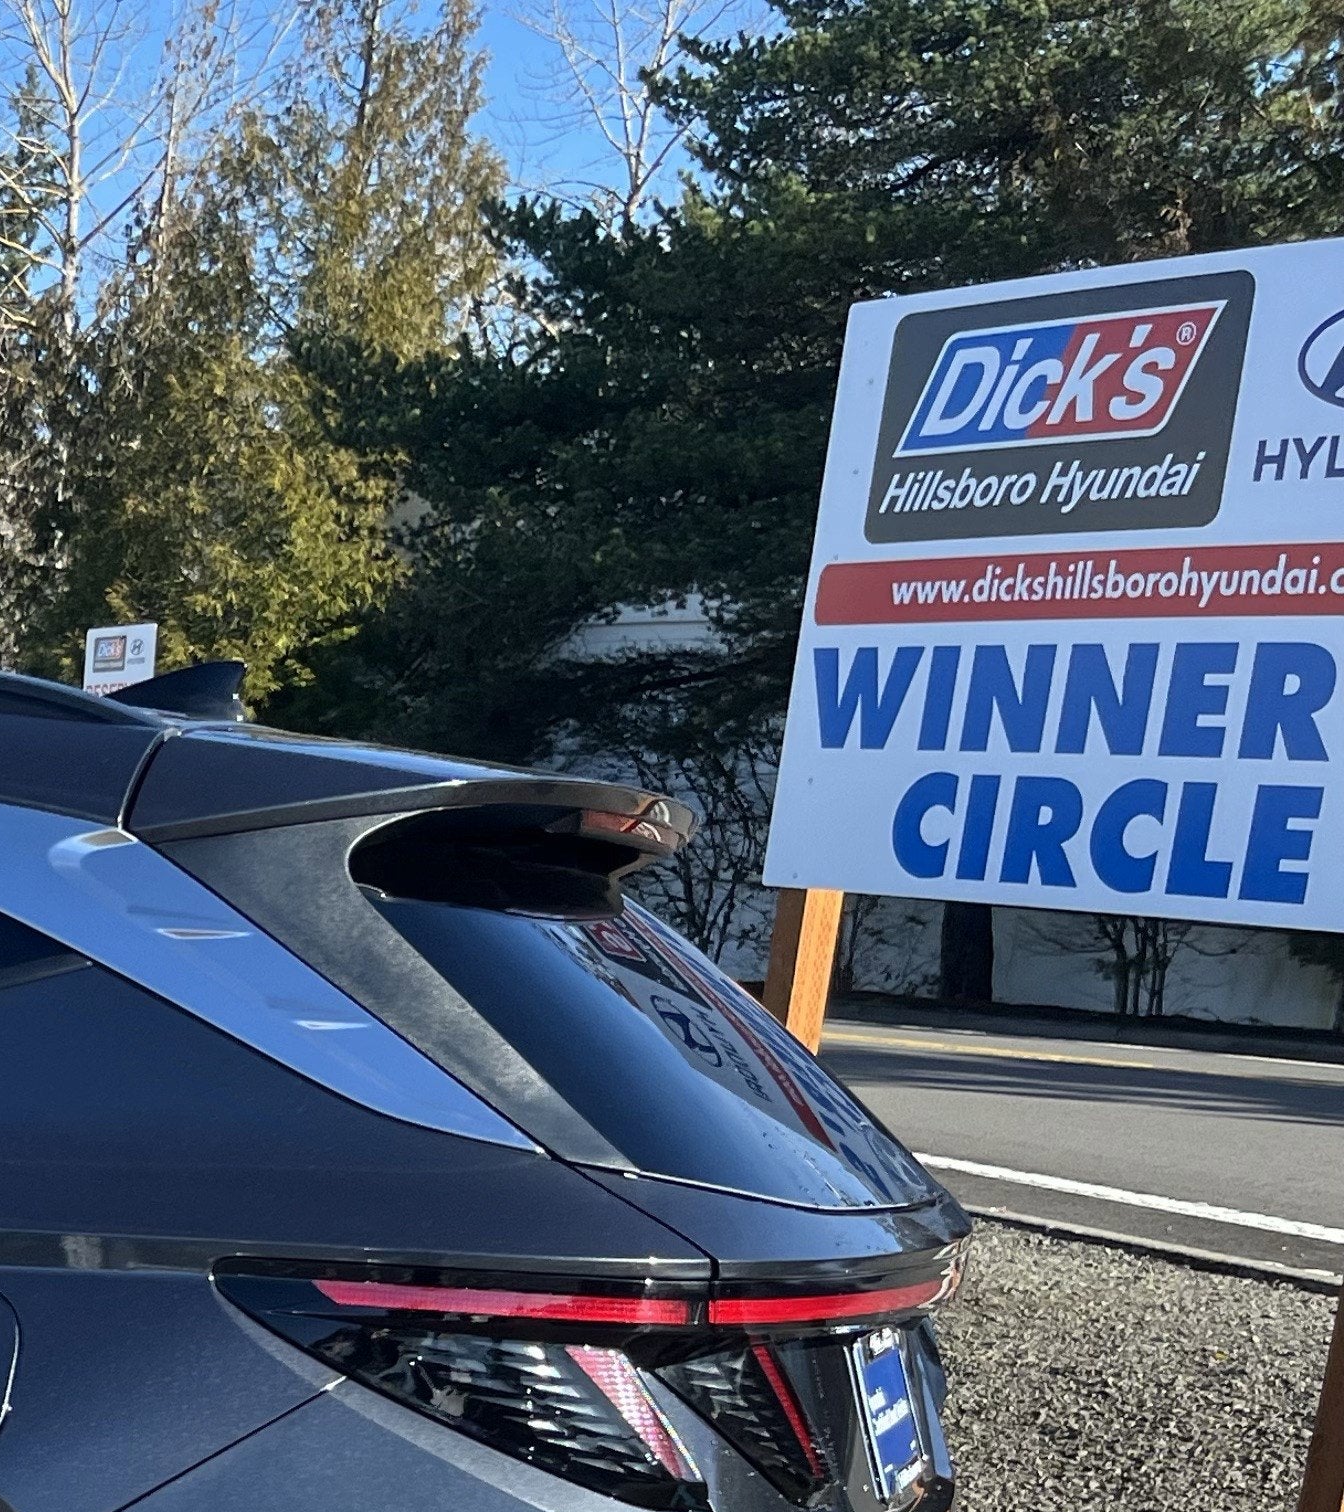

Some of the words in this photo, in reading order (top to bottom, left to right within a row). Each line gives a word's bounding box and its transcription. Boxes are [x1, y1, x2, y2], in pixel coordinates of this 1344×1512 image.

[878, 467, 1037, 514] Hillsboro
[1039, 450, 1207, 514] Hyundai
[812, 640, 1336, 762] WINNER
[891, 771, 1326, 905] CIRCLE
